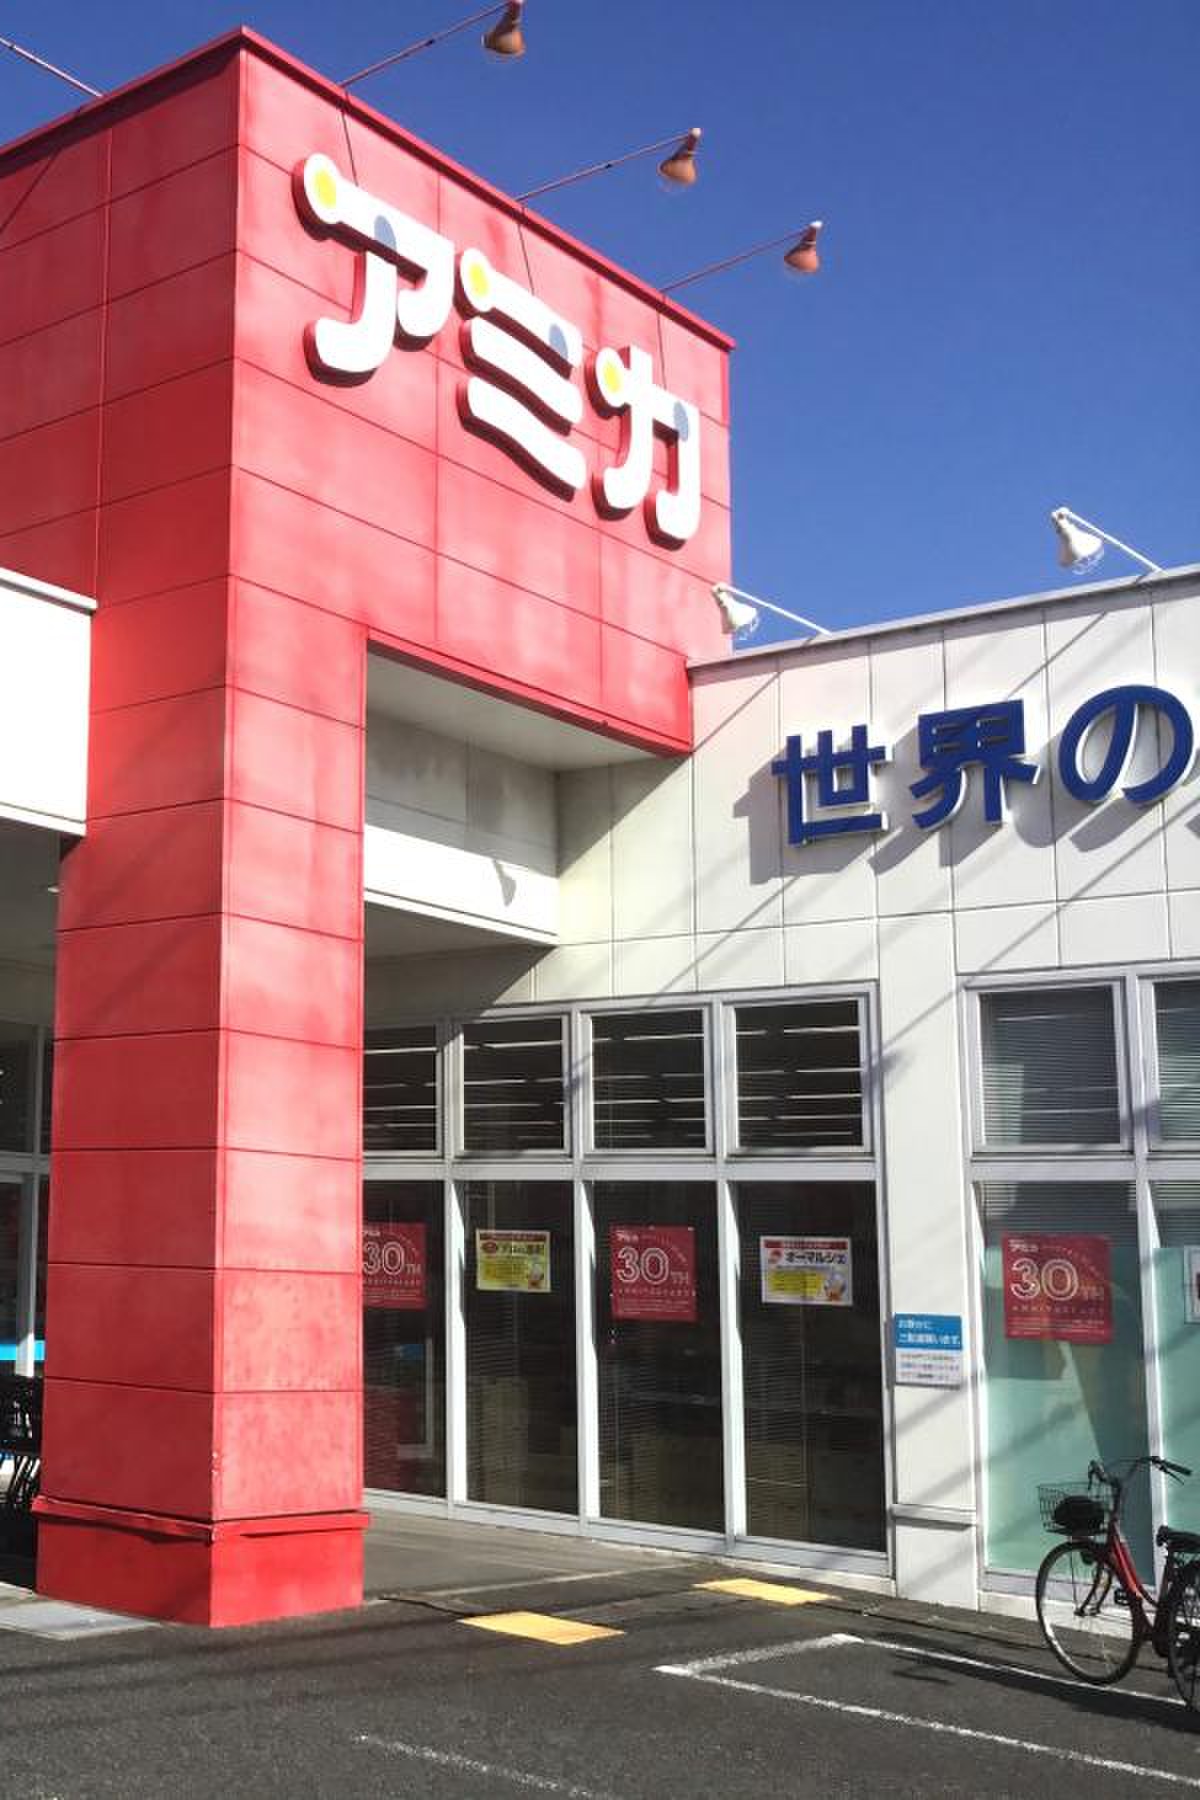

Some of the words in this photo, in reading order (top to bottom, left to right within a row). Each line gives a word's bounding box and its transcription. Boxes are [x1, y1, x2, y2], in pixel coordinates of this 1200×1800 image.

[294, 152, 701, 548] アミカ
[771, 684, 1194, 848] 世界の
